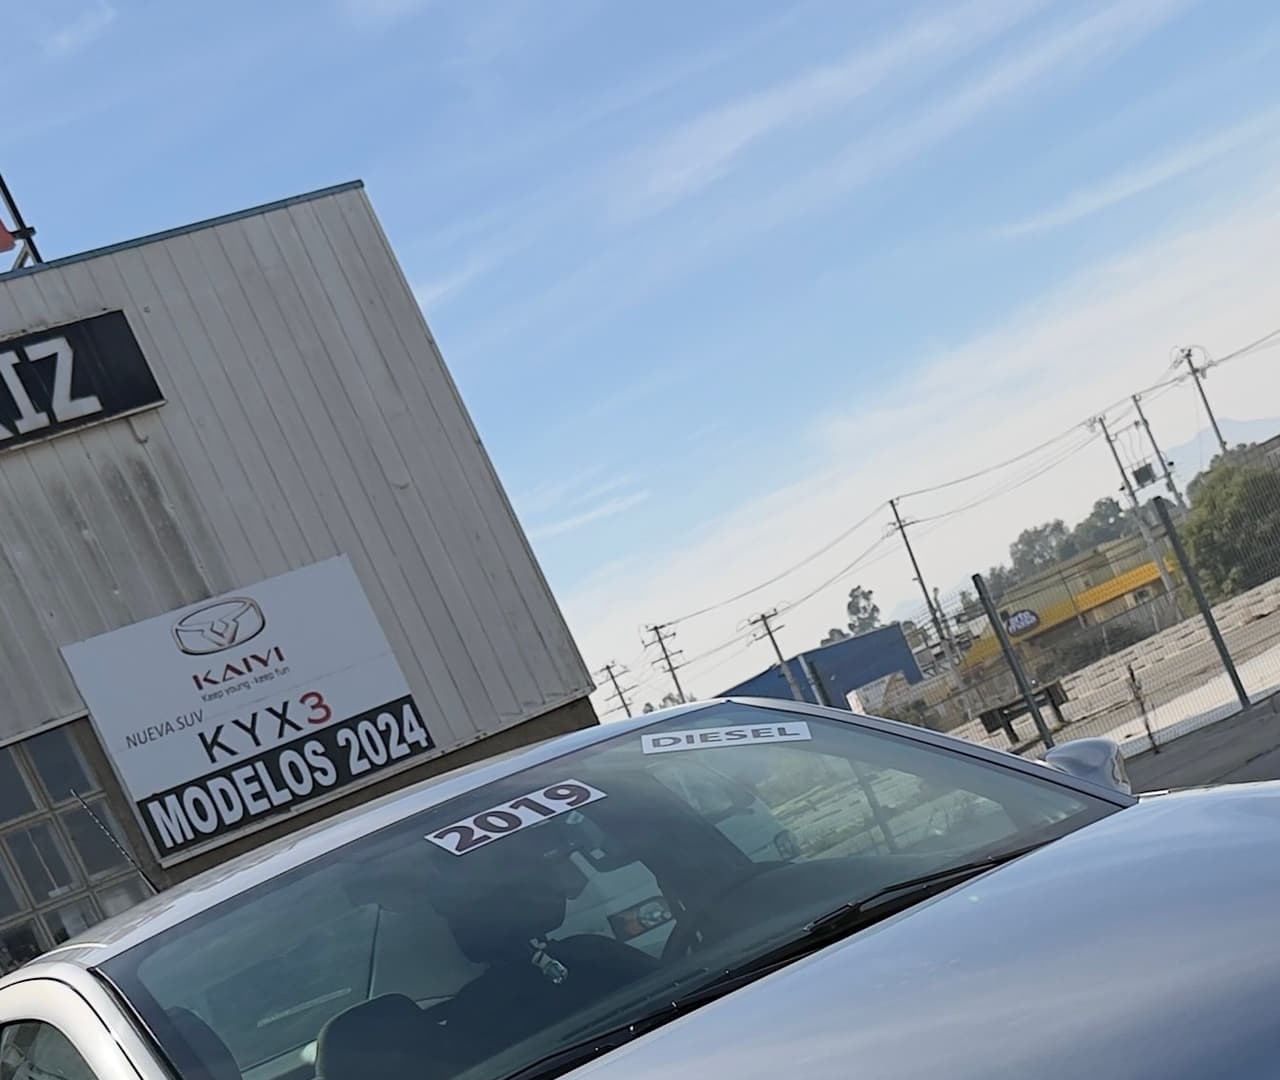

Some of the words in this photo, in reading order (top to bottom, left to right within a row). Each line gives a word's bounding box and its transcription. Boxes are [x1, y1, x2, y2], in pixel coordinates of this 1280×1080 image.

[125, 722, 175, 749] NUEVA
[176, 709, 204, 732] SUV
[197, 691, 332, 764] KYX3
[651, 726, 801, 748] DIESEL
[147, 740, 337, 848] MODELOS
[337, 703, 429, 776] 2024
[433, 783, 592, 851] 2019
